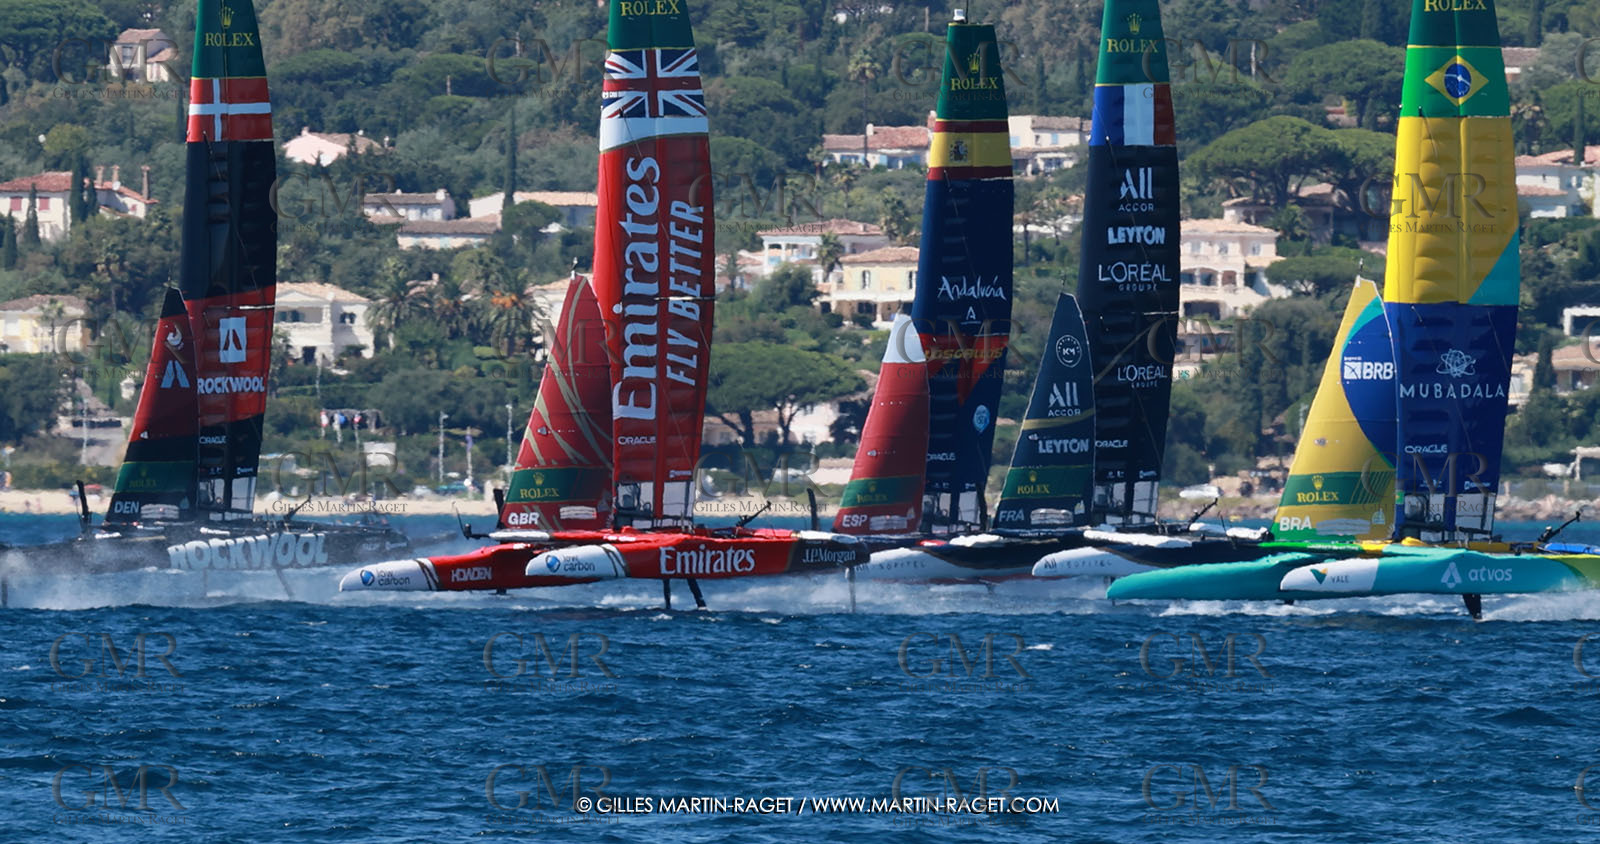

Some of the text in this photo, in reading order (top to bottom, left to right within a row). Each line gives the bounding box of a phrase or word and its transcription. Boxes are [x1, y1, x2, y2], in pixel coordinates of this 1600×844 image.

[620, 0, 681, 16] ROLEX
[1424, 0, 1488, 12] ROLEX
[204, 32, 255, 47] ROLEX
[1106, 38, 1159, 54] ROLEX
[951, 77, 999, 91] ROLEX
[1119, 166, 1154, 200] All
[1118, 203, 1155, 212] ACCOR
[1107, 225, 1166, 246] LEYTON
[1097, 260, 1173, 283] L'ORÉAL
[612, 156, 661, 420] Emirates
[666, 200, 705, 386] FLY BETTER
[1118, 283, 1158, 292] GROUPE
[1362, 362, 1394, 380] BRB
[197, 376, 265, 394] ROCKWOOL
[1399, 383, 1506, 399] MUBADALA
[1047, 382, 1080, 408] All
[1047, 408, 1081, 417] ACCOR
[617, 435, 657, 445] ORACLE
[1038, 438, 1090, 454] LEYTON
[1094, 439, 1129, 448] ORACLE
[1404, 444, 1448, 454] ORACLE
[519, 487, 561, 499] ROLEX
[1017, 484, 1051, 495] ROLEX
[1296, 491, 1340, 503] ROLEX
[114, 500, 140, 513] DEN
[508, 511, 540, 526] GBR
[842, 514, 868, 528] ESP
[998, 508, 1025, 522] FRA
[1279, 515, 1313, 531] BRA
[167, 532, 329, 569] ROCKWOOL
[659, 543, 756, 575] Emirates
[451, 566, 493, 582] HOWDEN
[563, 562, 596, 573] carbon
[1468, 566, 1513, 582] atvos
[377, 574, 411, 586] carbon
[1330, 574, 1351, 584] VALE
